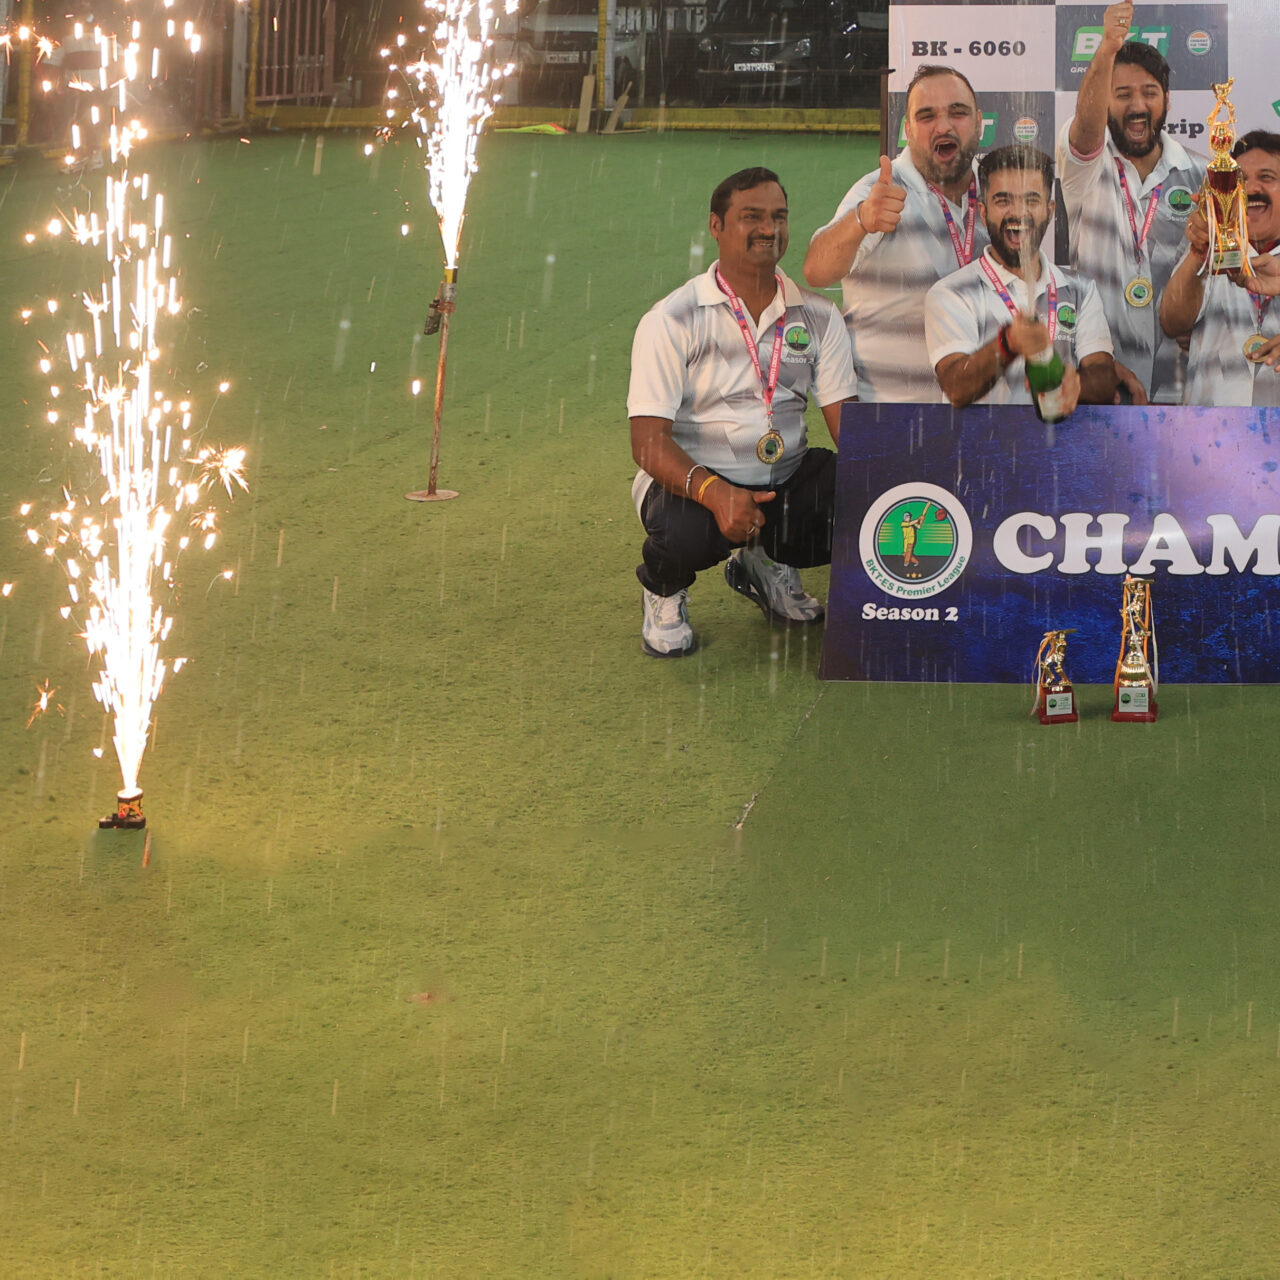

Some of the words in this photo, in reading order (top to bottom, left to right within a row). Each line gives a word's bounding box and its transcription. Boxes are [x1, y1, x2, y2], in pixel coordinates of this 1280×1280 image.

[912, 41, 947, 56] BK
[968, 40, 1026, 57] 6060
[1075, 32, 1168, 54] BT
[1161, 120, 1204, 139] rip
[895, 584, 936, 597] Premier
[937, 555, 966, 588] League
[861, 602, 939, 621] Season
[944, 606, 959, 622] 2
